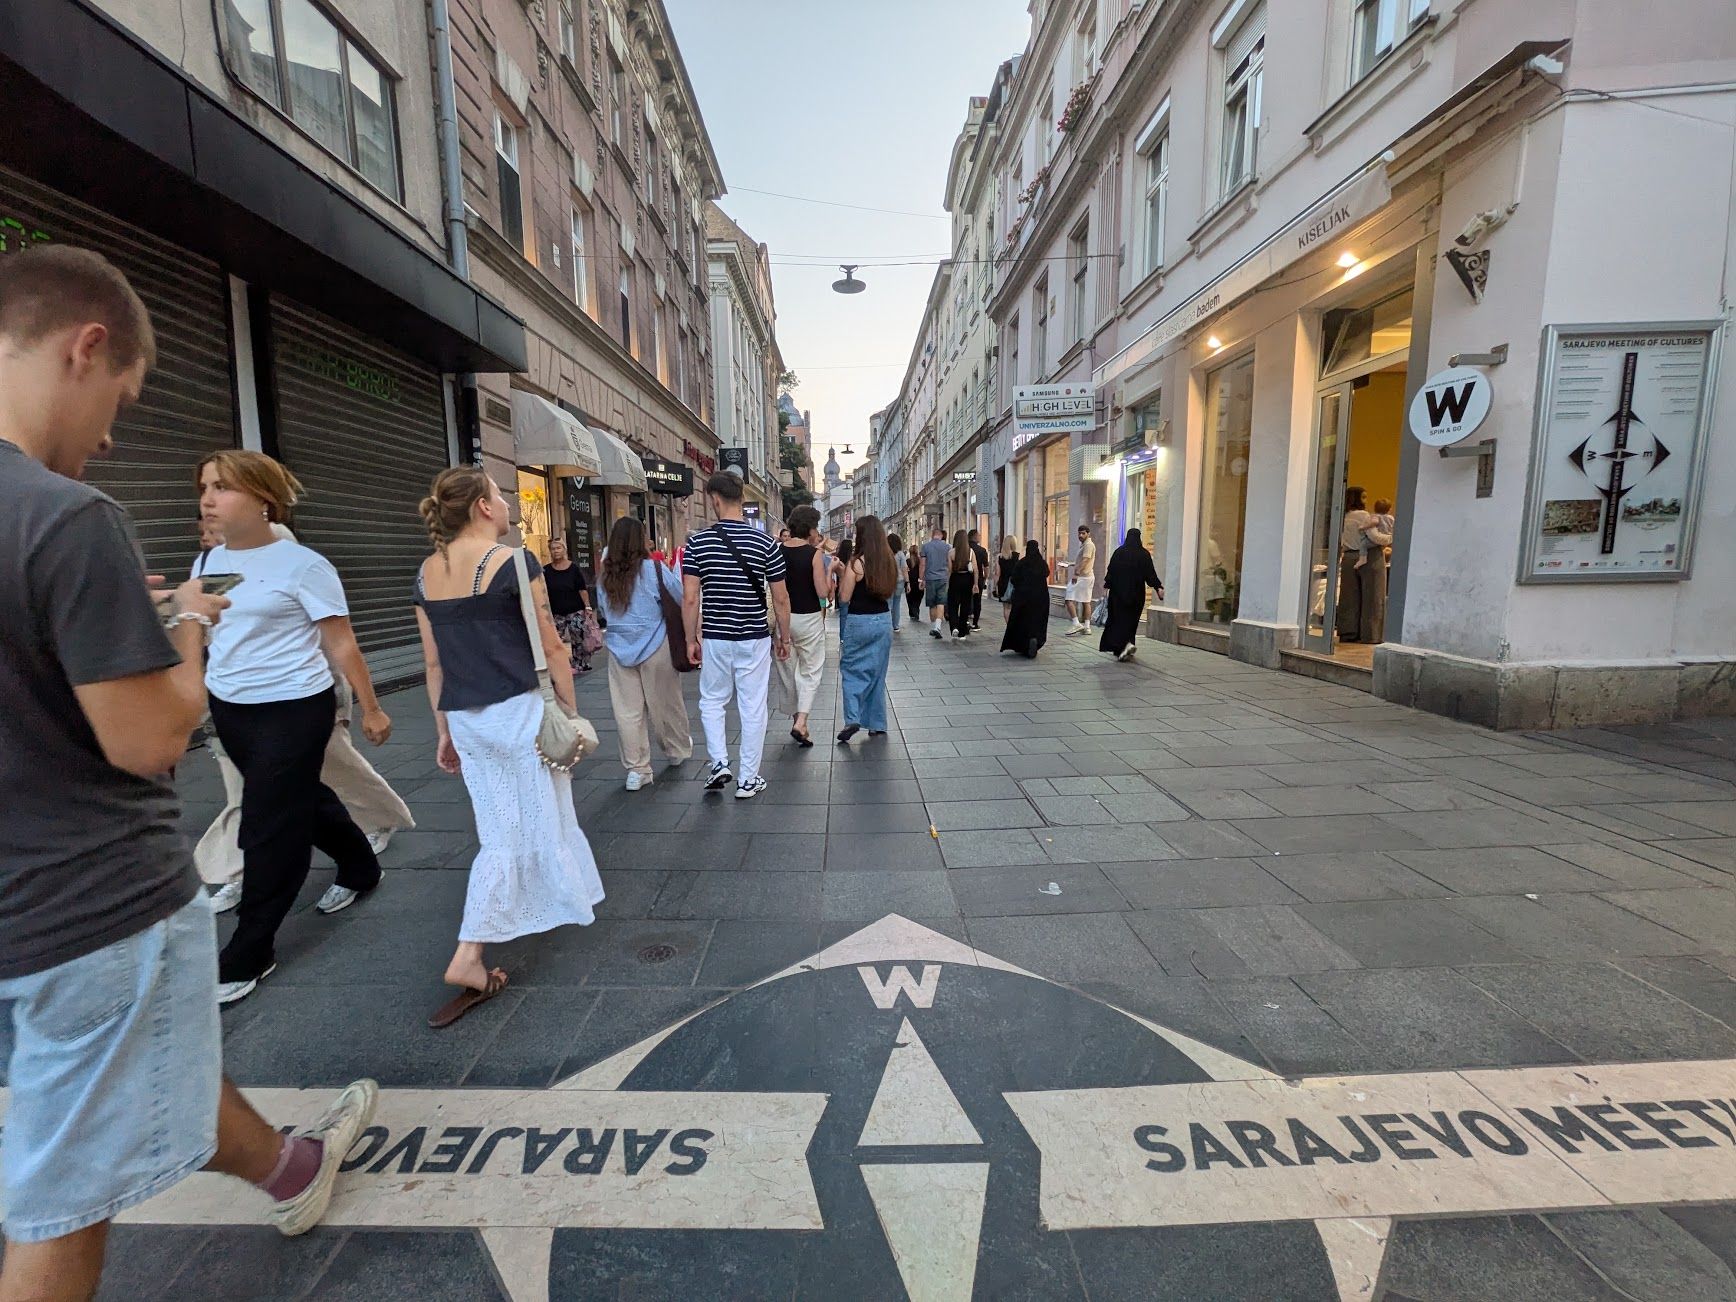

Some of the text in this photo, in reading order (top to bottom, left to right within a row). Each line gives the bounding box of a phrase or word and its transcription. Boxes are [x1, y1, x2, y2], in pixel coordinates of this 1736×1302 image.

[1298, 204, 1350, 249] KISELJAK
[1196, 294, 1221, 318] badem
[1562, 337, 1704, 348] SARAJEVO MEETING OF CULTURES
[1032, 400, 1092, 412] HIGH LEVEL
[1425, 381, 1477, 428] W
[1019, 420, 1087, 430] UNIVERZALNO.COM
[1430, 428, 1444, 436] SPIN
[644, 470, 682, 482] LATARNA CELJE
[570, 494, 590, 513] Gema
[857, 964, 942, 1009] W
[337, 1126, 715, 1176] SARAJEVO
[1133, 1109, 1529, 1173] SARAJEVO
